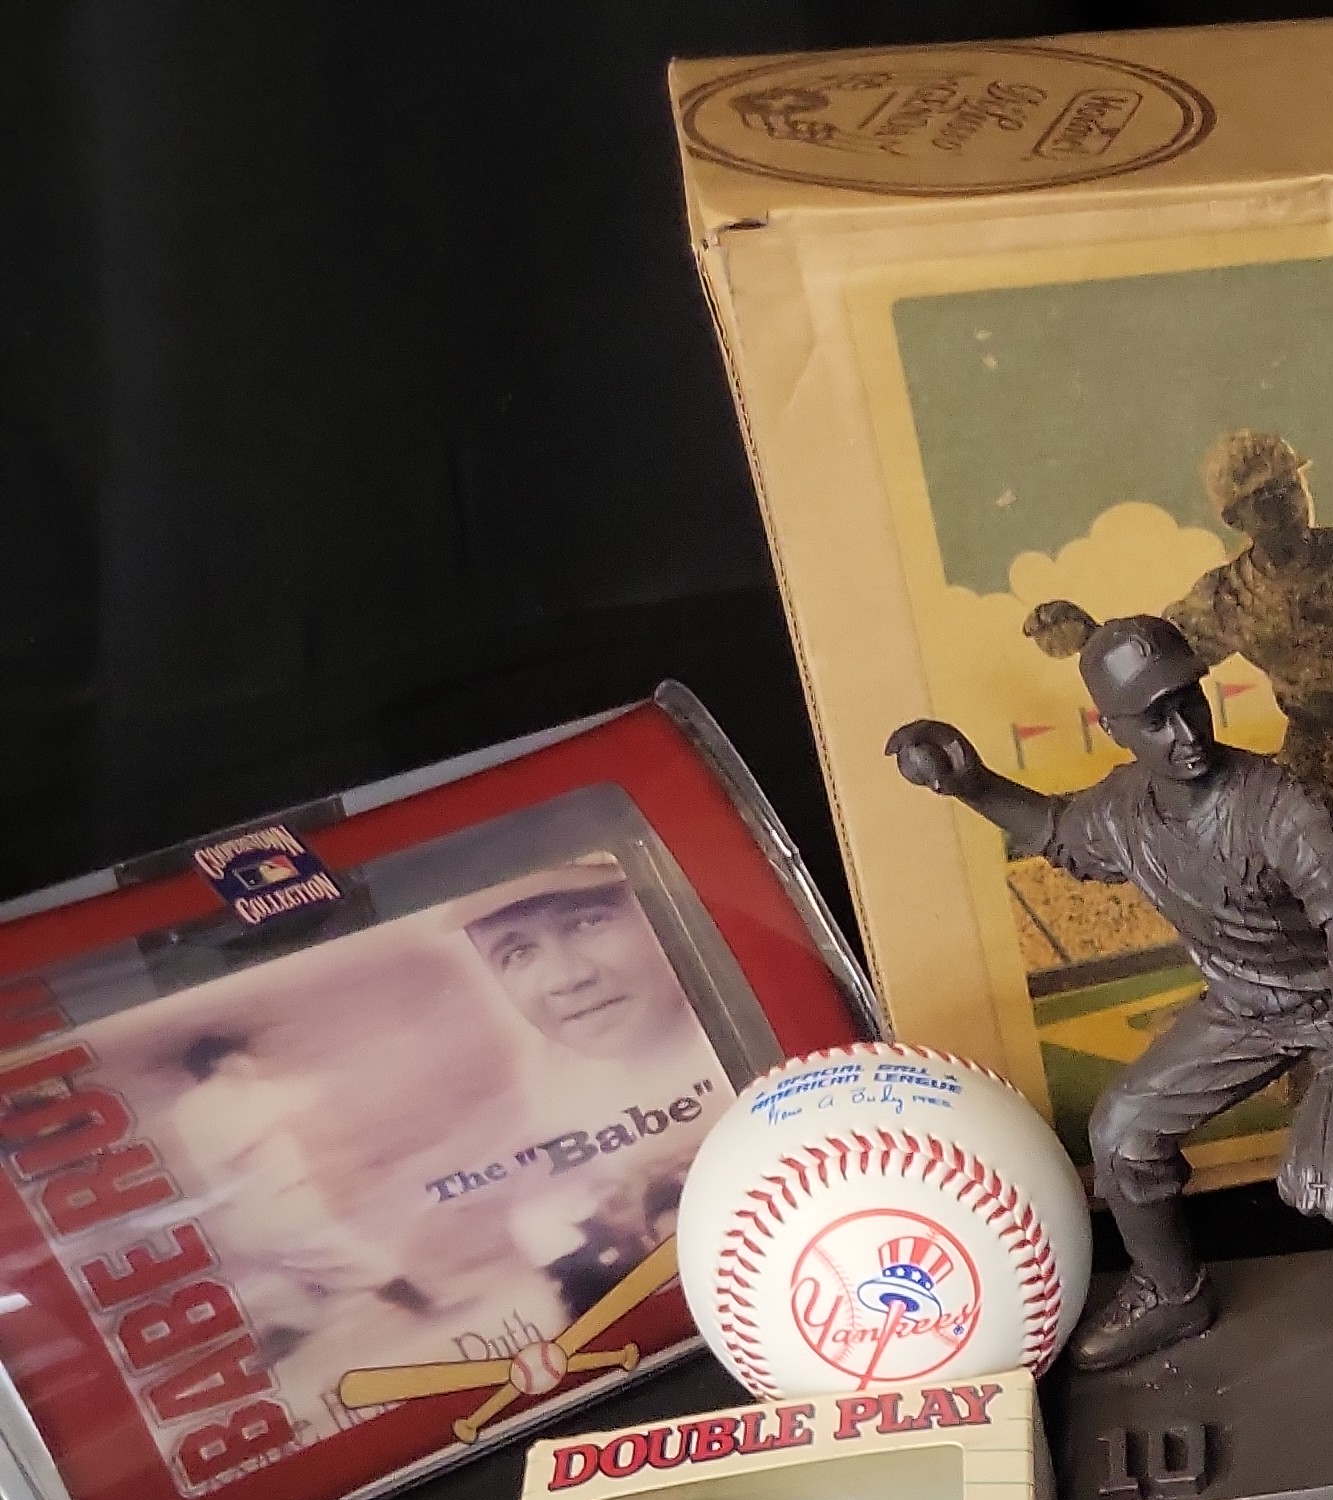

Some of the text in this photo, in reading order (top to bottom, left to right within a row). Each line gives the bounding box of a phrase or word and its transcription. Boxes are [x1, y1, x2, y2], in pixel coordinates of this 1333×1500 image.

[873, 1072, 964, 1096] LEAGUE
[425, 1079, 716, 1206] The "Babe"
[74, 1218, 304, 1498] BABE
[790, 1275, 982, 1370] Yankees
[547, 1384, 1003, 1492] DOUBLE PLAY
